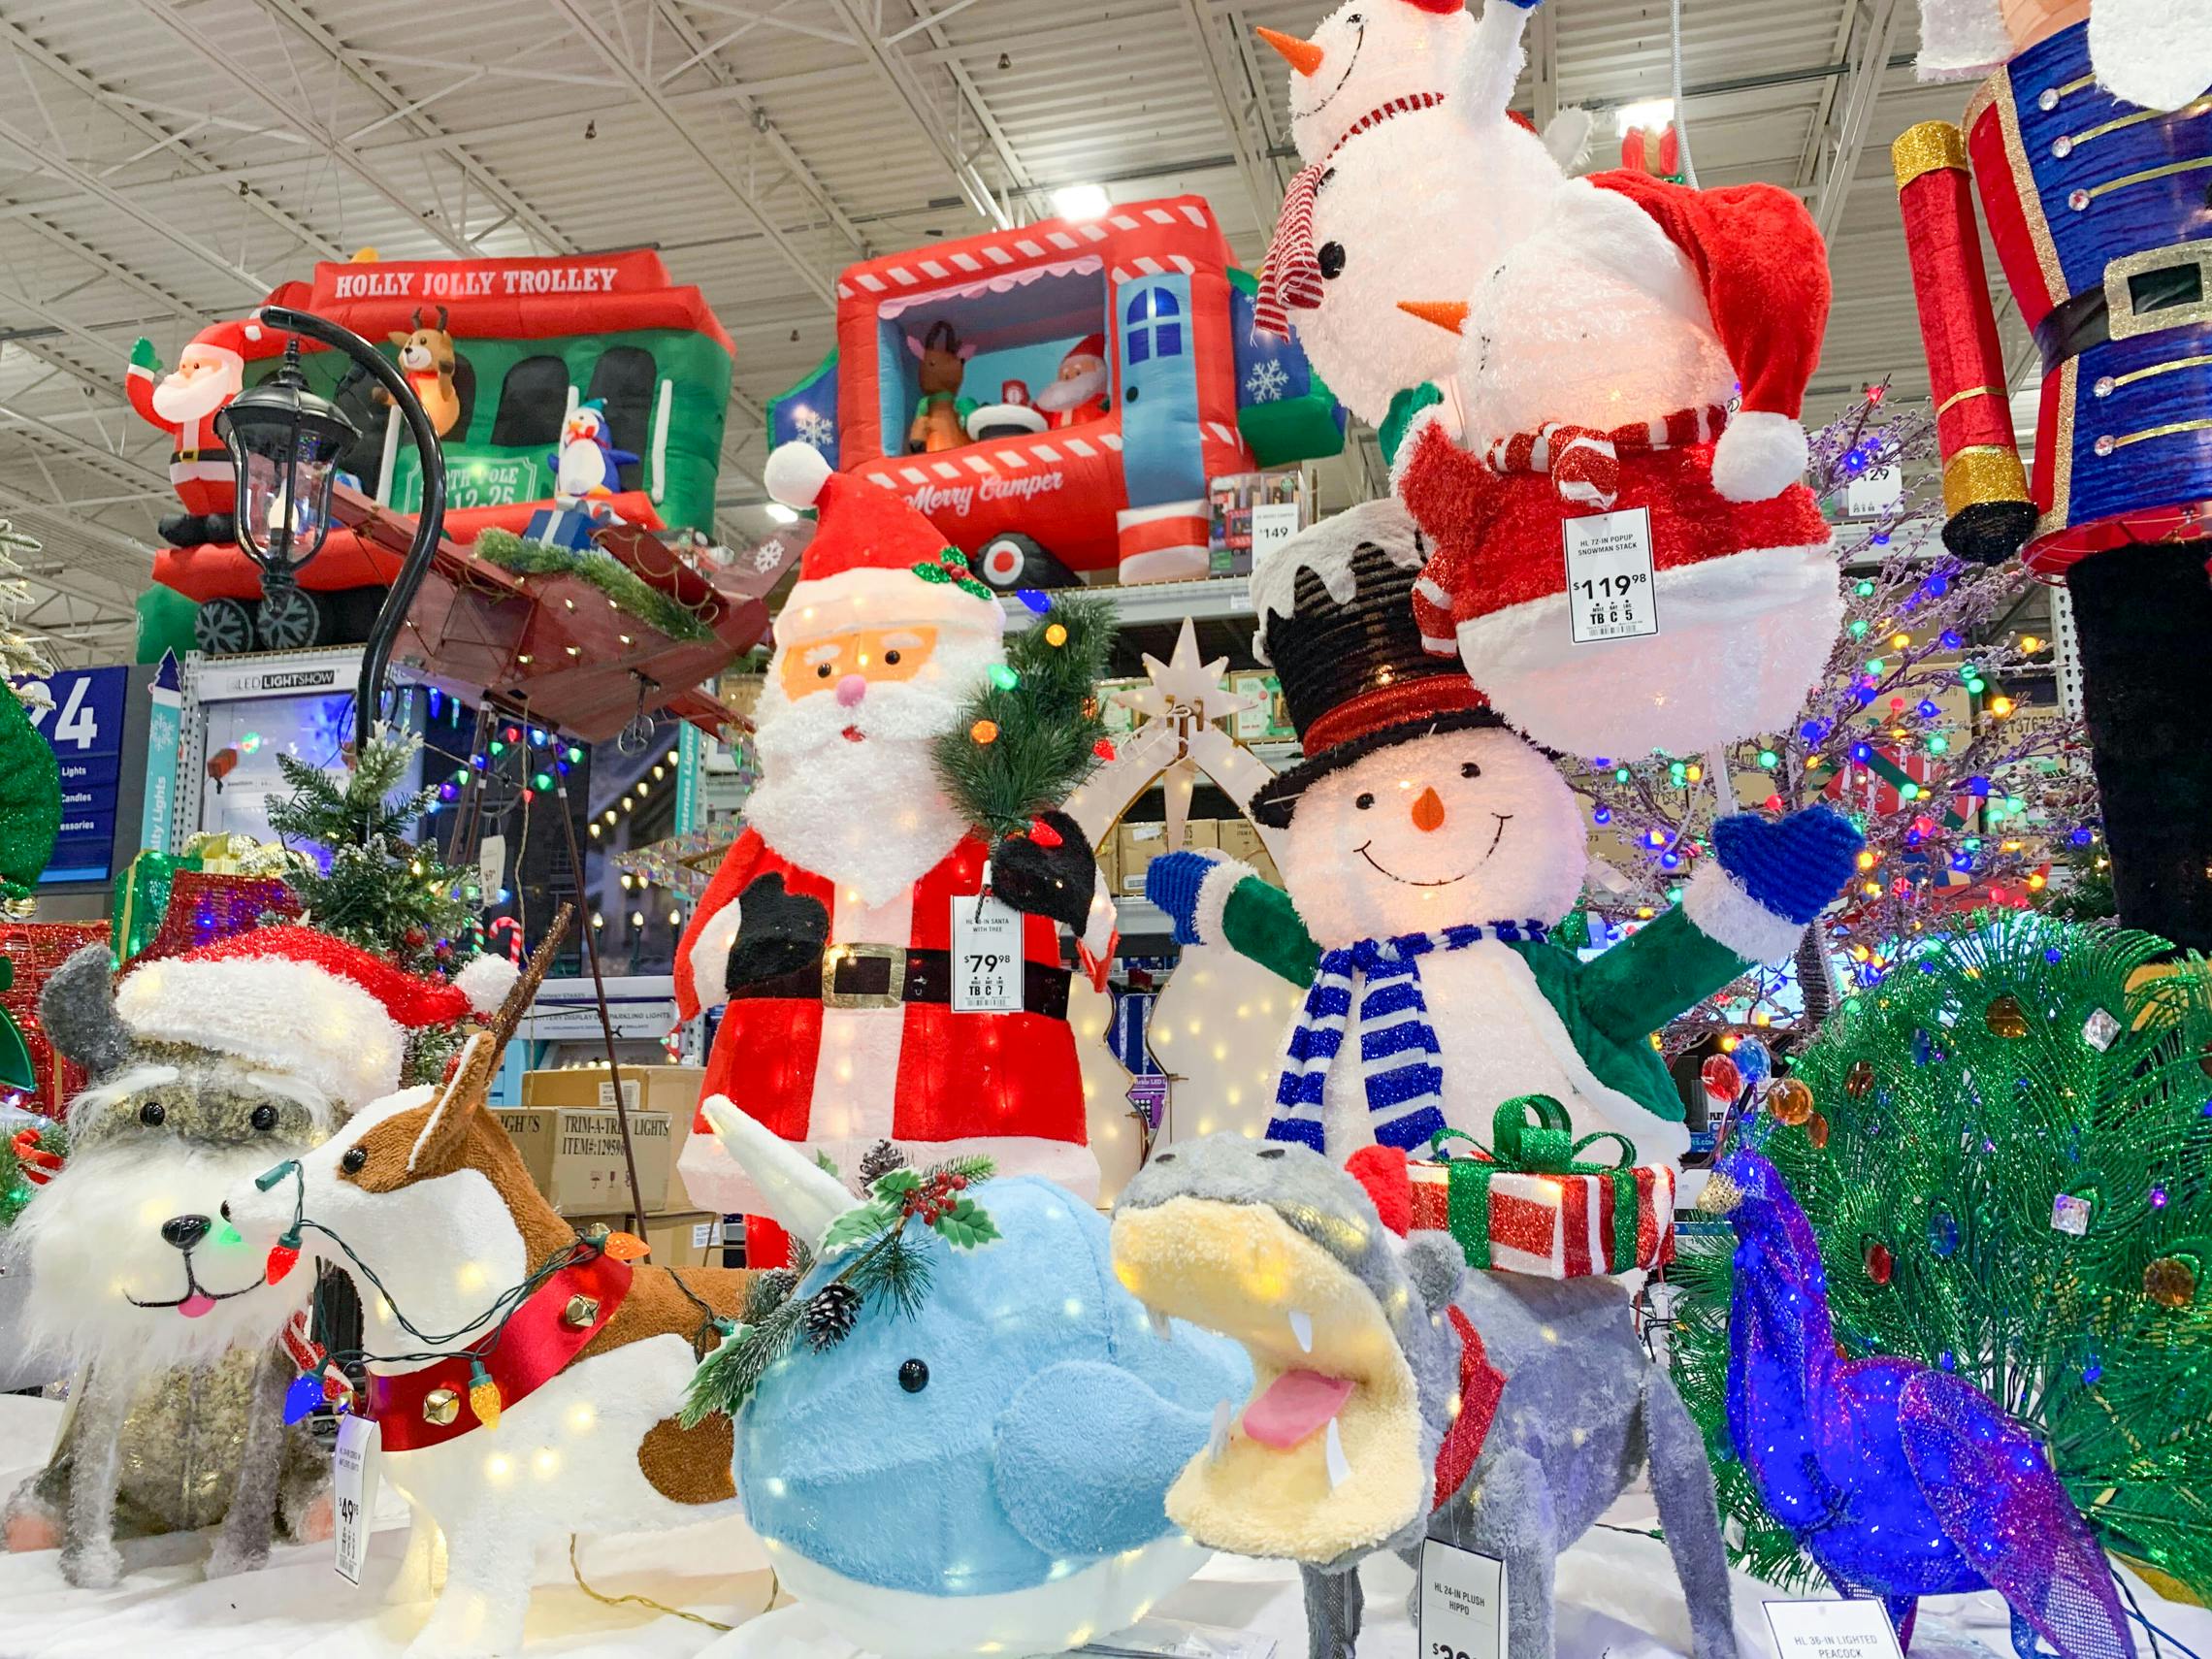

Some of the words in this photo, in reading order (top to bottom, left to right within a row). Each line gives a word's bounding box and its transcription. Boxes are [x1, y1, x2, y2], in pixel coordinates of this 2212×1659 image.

[335, 273, 414, 298] HOLLY
[422, 272, 496, 296] JOLLY
[503, 268, 618, 294] TROLLEY
[904, 484, 974, 517] Merry
[979, 472, 1063, 502] Camper
[1610, 534, 1634, 543] POPUP
[1578, 545, 1613, 556] SNOWMAN
[1615, 542, 1638, 552] STACK
[1590, 613, 1605, 625] TB
[1610, 611, 1617, 622] C
[1625, 609, 1633, 621] 5
[684, 727, 694, 775] Lights
[61, 766, 86, 776] Lights
[152, 776, 167, 823] Lights
[60, 821, 94, 831] essories
[969, 986, 981, 995] TB
[985, 985, 992, 995] C
[997, 985, 1003, 995] 7
[501, 1115, 540, 1133] IGHTS
[634, 1119, 668, 1136] LIGHTS
[1434, 1581, 1443, 1593] HL
[1444, 1585, 1461, 1599] 24-IN
[1462, 1591, 1485, 1607] PLUSH
[1449, 1601, 1470, 1615] HIPPO
[1794, 1637, 1807, 1645] HL
[1809, 1636, 1835, 1645] 36-IN
[1838, 1635, 1878, 1645] LIGHTED
[1818, 1648, 1863, 1658] PEACOCK
